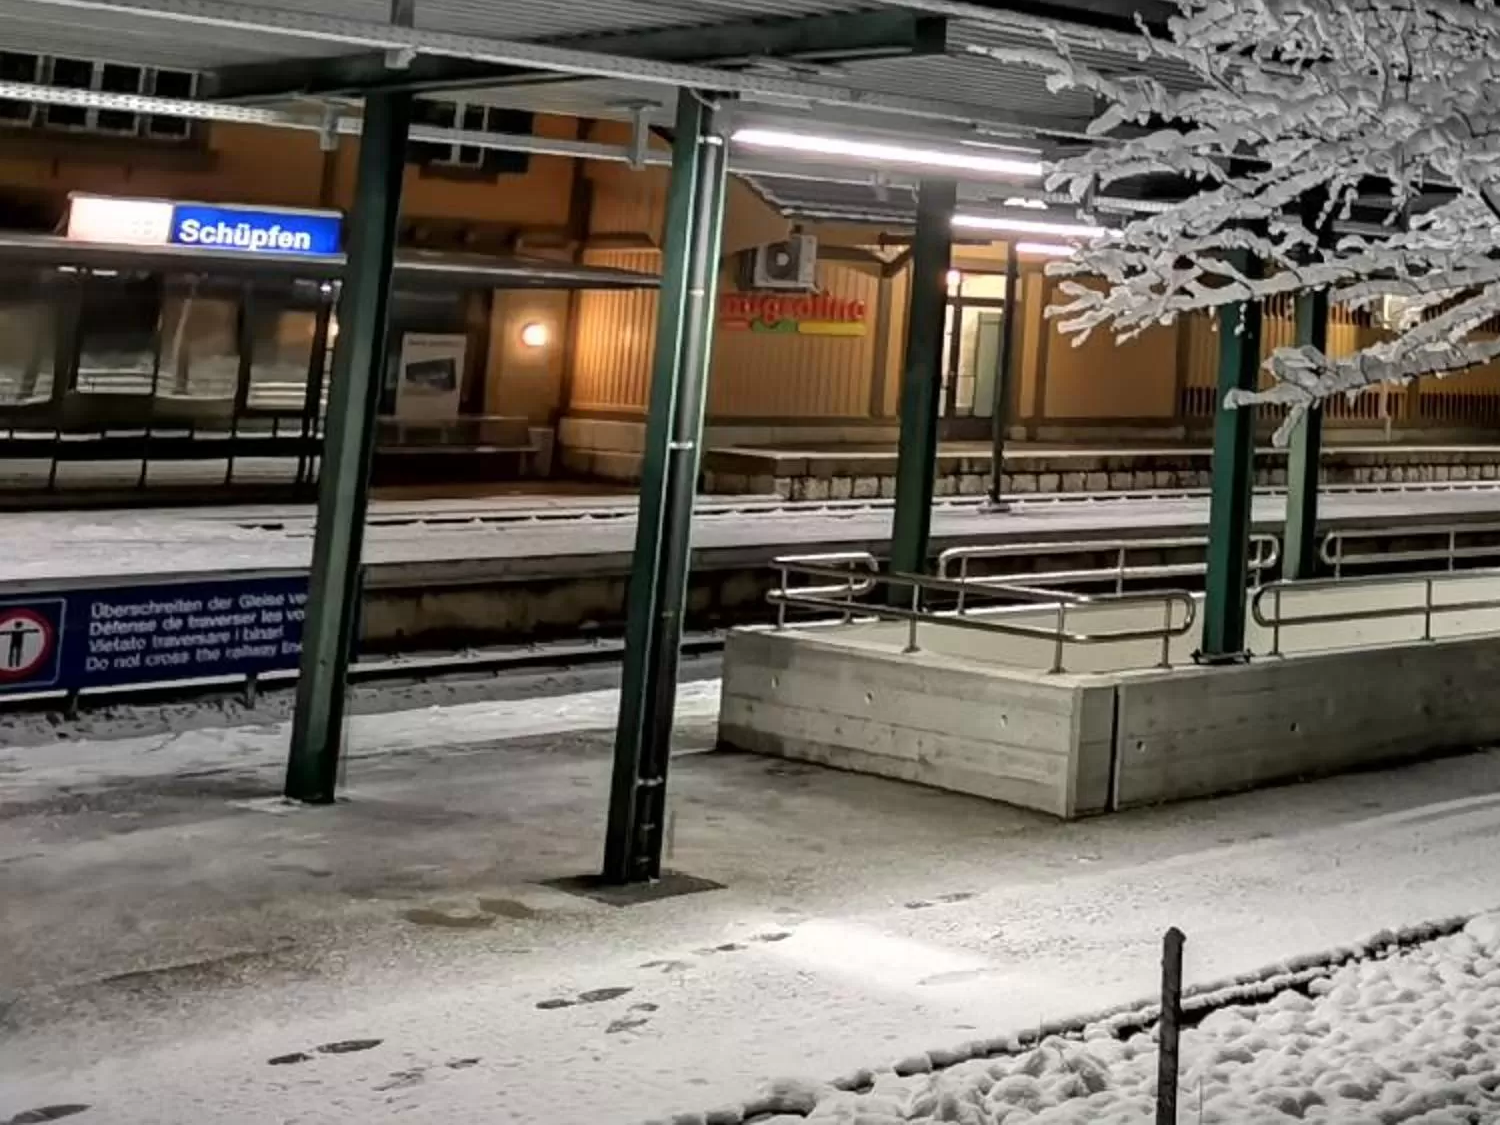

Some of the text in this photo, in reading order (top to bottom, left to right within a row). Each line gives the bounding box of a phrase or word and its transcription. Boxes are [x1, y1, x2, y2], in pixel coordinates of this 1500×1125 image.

[179, 219, 311, 251] Schüpfen
[207, 596, 233, 612] der
[162, 615, 183, 631] de
[187, 612, 257, 628] traverser
[88, 636, 147, 653] Vietato
[85, 656, 109, 672] Do
[114, 652, 141, 668] not
[145, 651, 190, 667] cross
[195, 647, 221, 663] the
